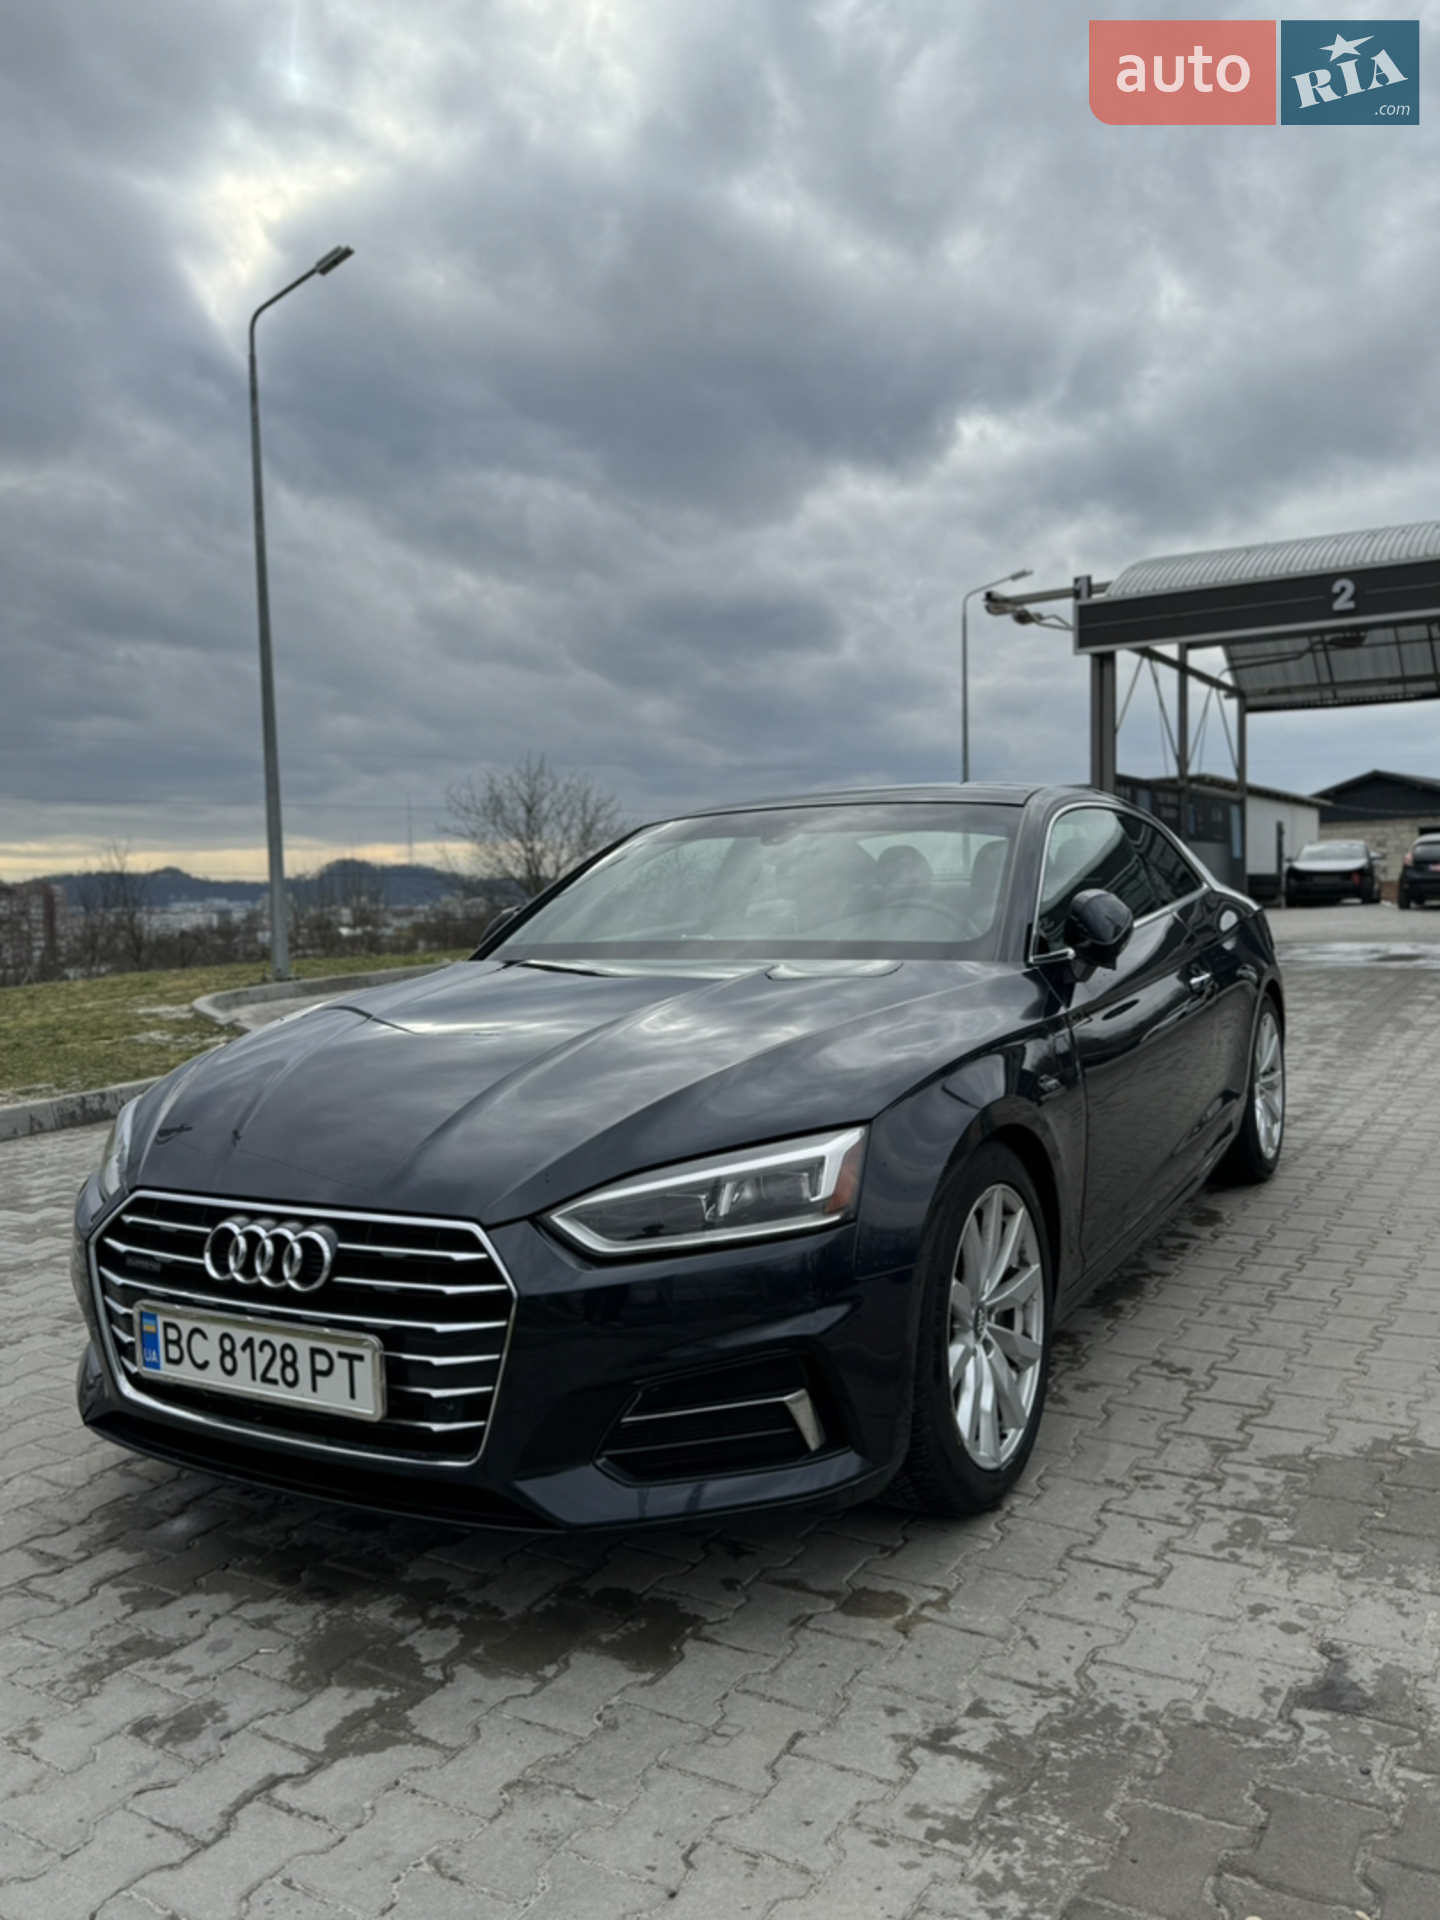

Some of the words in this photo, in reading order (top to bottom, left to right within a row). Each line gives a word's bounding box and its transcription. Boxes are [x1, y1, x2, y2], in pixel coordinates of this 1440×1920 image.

[1332, 579, 1355, 611] 2
[144, 1348, 159, 1363] UA
[163, 1321, 210, 1371] BC
[219, 1332, 300, 1389] 8128
[309, 1346, 365, 1401] PT
